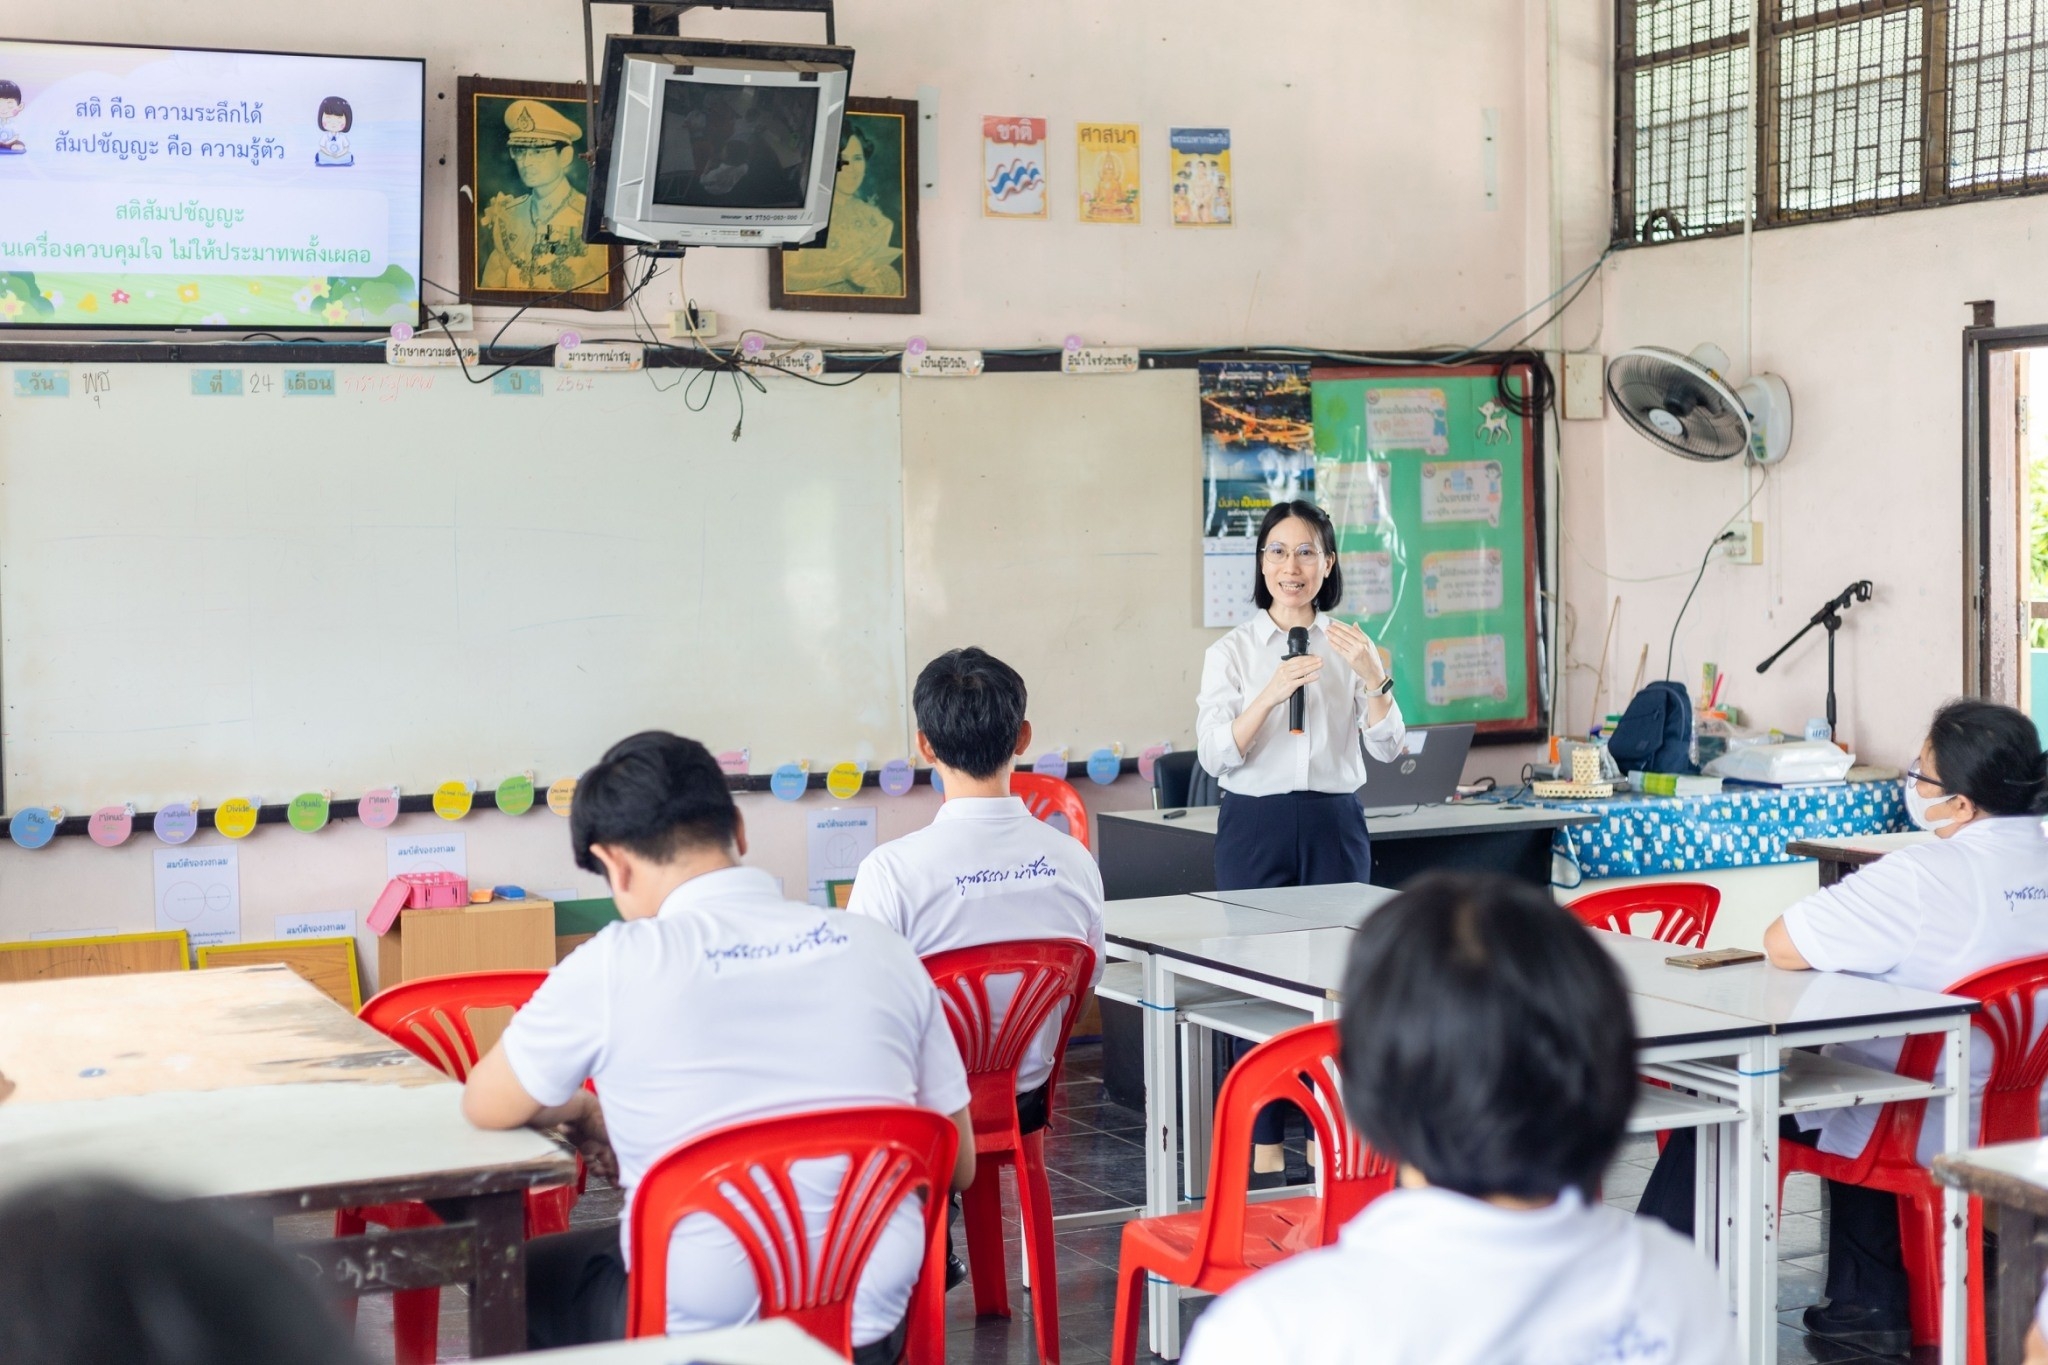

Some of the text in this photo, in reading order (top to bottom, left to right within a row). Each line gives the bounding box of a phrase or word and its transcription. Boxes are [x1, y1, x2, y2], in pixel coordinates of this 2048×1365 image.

[75, 96, 263, 125] สติ คือ ความระลึกได้
[996, 118, 1033, 142] ชาติ
[1080, 126, 1137, 145] ศาสนา
[54, 130, 286, 167] สัมปชัญญะ คือ ความรู้ตัว
[115, 199, 245, 228] สติสัมปชัญญะ
[169, 233, 372, 265] ไม่ให้ประมาทพลั้งเผลอ
[393, 344, 475, 358] รักษาความสะาด
[29, 371, 55, 392] วัน
[209, 374, 223, 393] ที่
[250, 373, 275, 394] 24
[287, 371, 332, 391] เดือน
[509, 371, 522, 391] ปี
[556, 375, 595, 393] 2567
[27, 812, 45, 825] Plus
[98, 812, 125, 823] Minus
[225, 804, 250, 813] Divide
